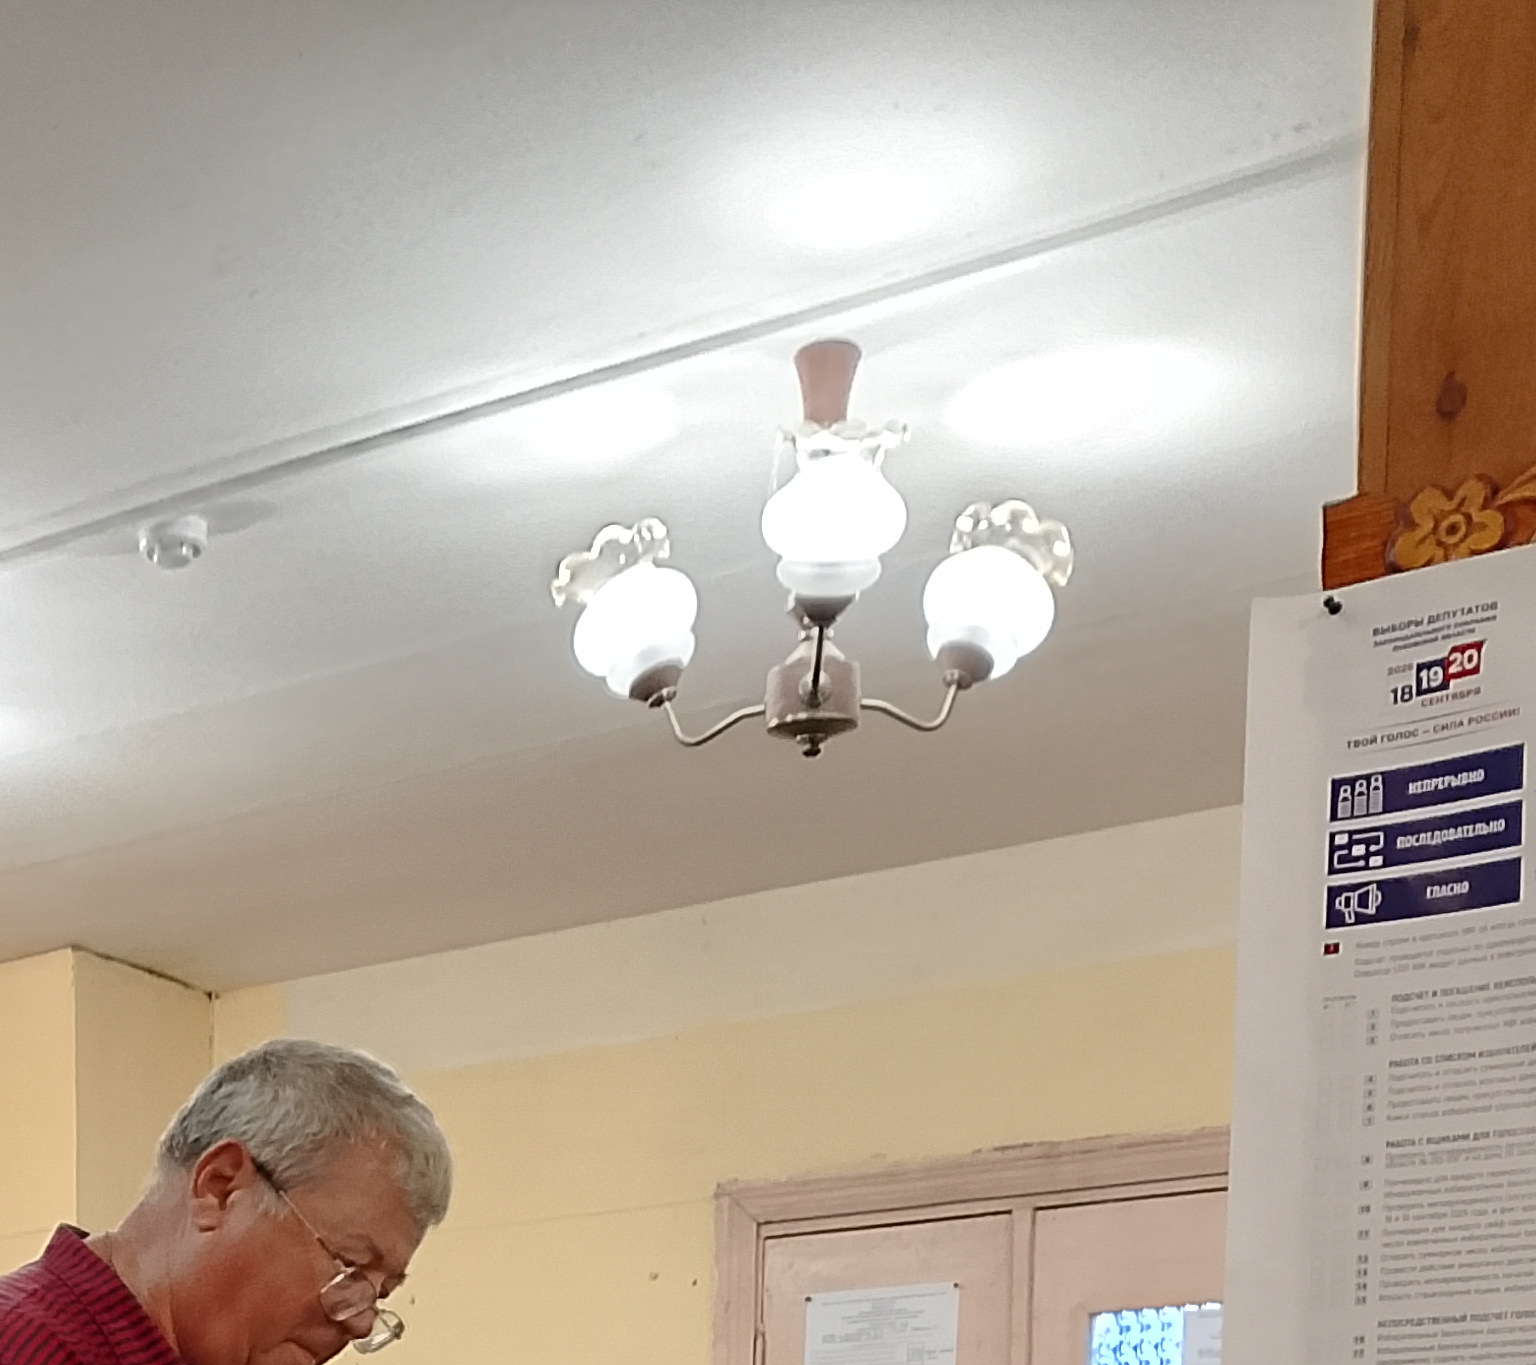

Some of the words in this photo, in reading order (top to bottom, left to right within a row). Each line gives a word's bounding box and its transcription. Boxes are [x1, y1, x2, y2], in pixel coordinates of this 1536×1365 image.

[1372, 617, 1424, 638] ВЫБОРЫ
[1427, 600, 1498, 627] ДЕПУТАТОВ
[1390, 684, 1414, 705] 18
[1418, 666, 1444, 690] 19
[1448, 649, 1479, 675] 20
[1421, 686, 1482, 708] СЕНТЯБРЯ
[1346, 734, 1378, 750] ТВОЙ
[1380, 728, 1419, 744] ГОЛОС
[1432, 718, 1465, 735] СИЛА
[1408, 768, 1486, 794] НЕПРЕРЫВНО
[1396, 818, 1506, 849] ПОСЛЕДОВАТЕЛЬНО
[1426, 880, 1470, 899] ГЛАСНО
